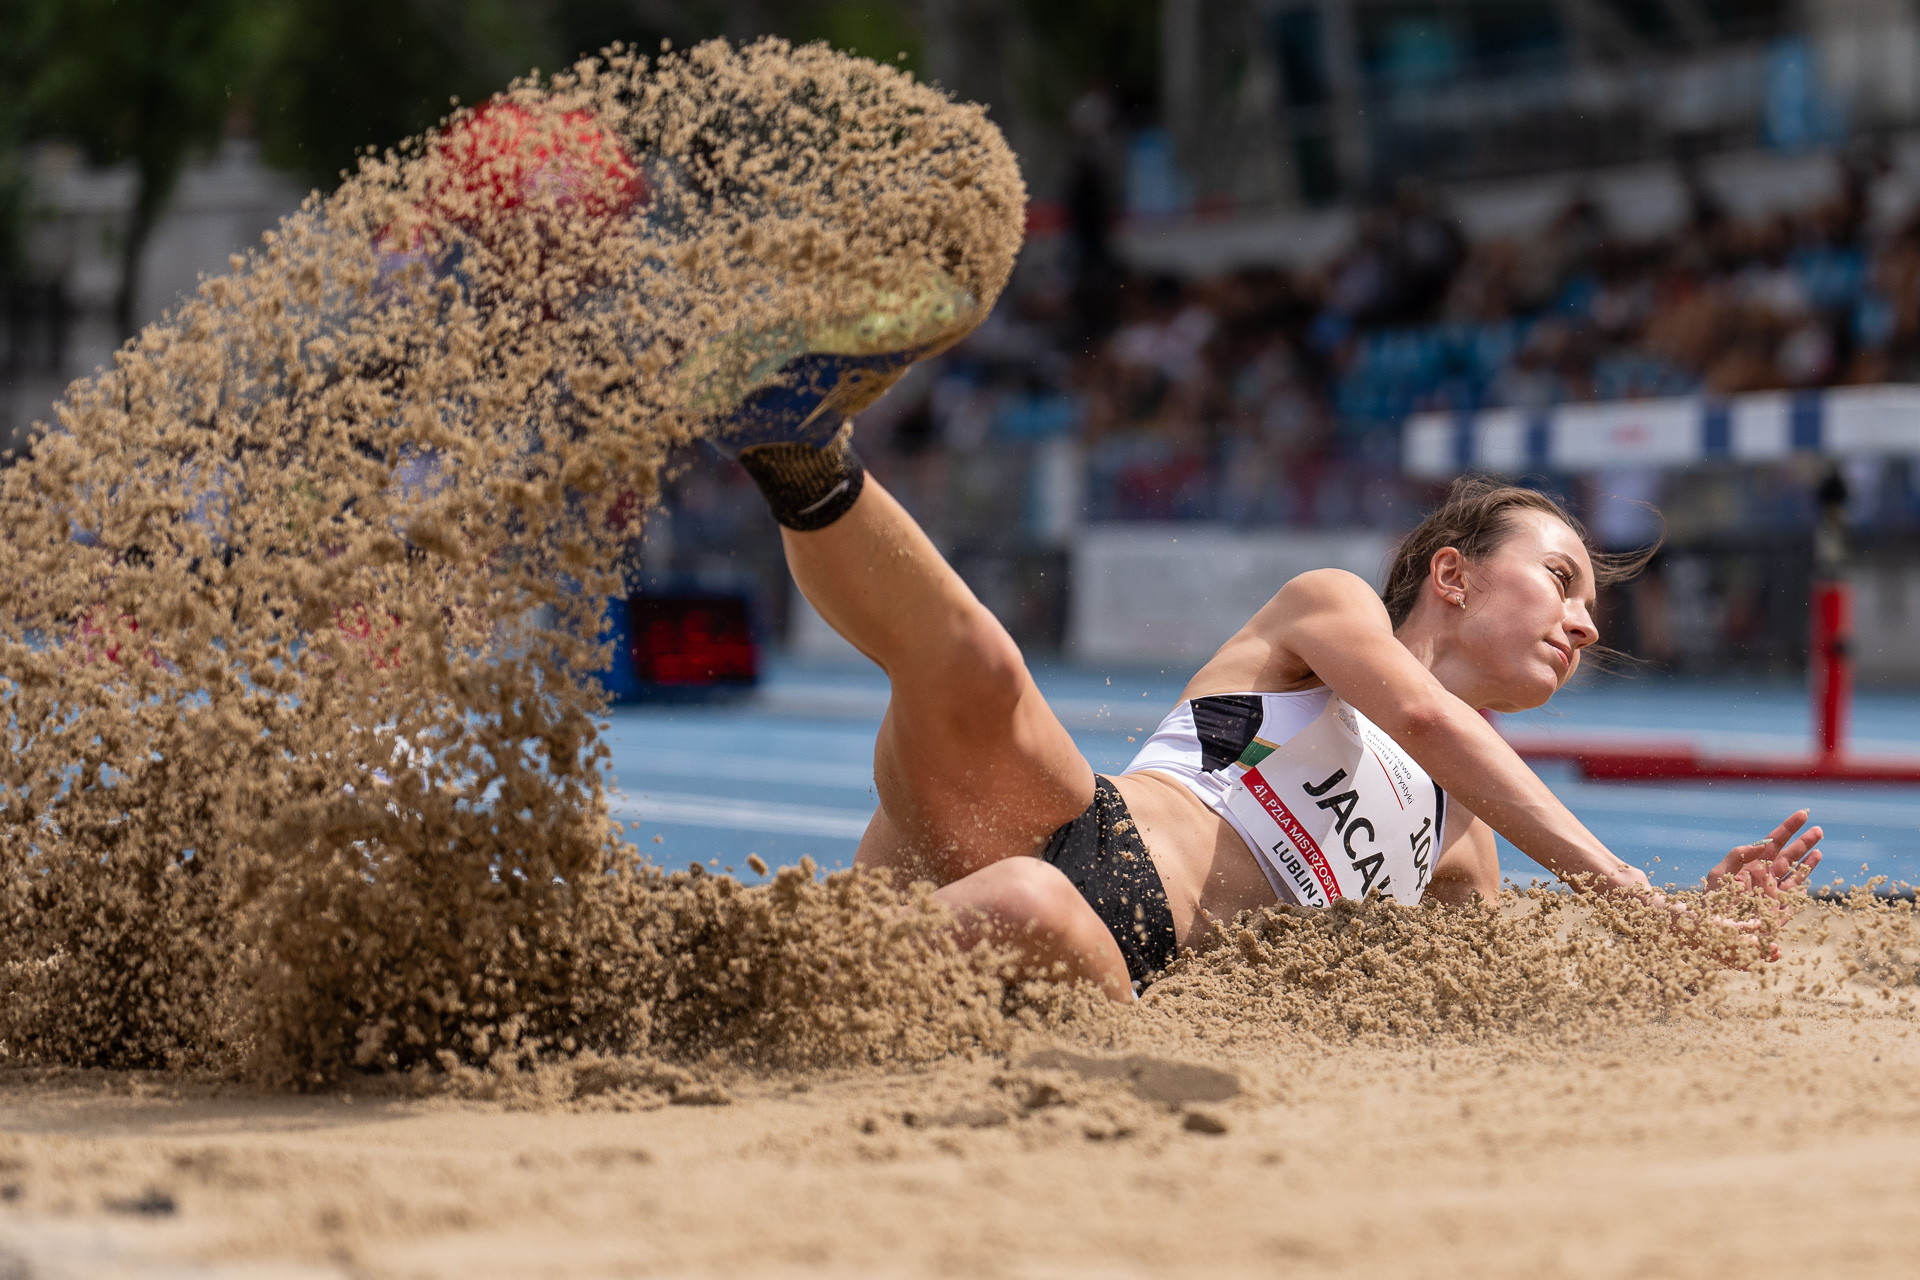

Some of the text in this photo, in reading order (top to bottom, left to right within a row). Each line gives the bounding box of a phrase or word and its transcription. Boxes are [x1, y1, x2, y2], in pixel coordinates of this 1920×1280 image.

[1392, 763, 1415, 805] Turystyki
[1254, 785, 1268, 801] 41.
[1266, 799, 1292, 828] PZLA
[1272, 840, 1318, 899] LUBLIN
